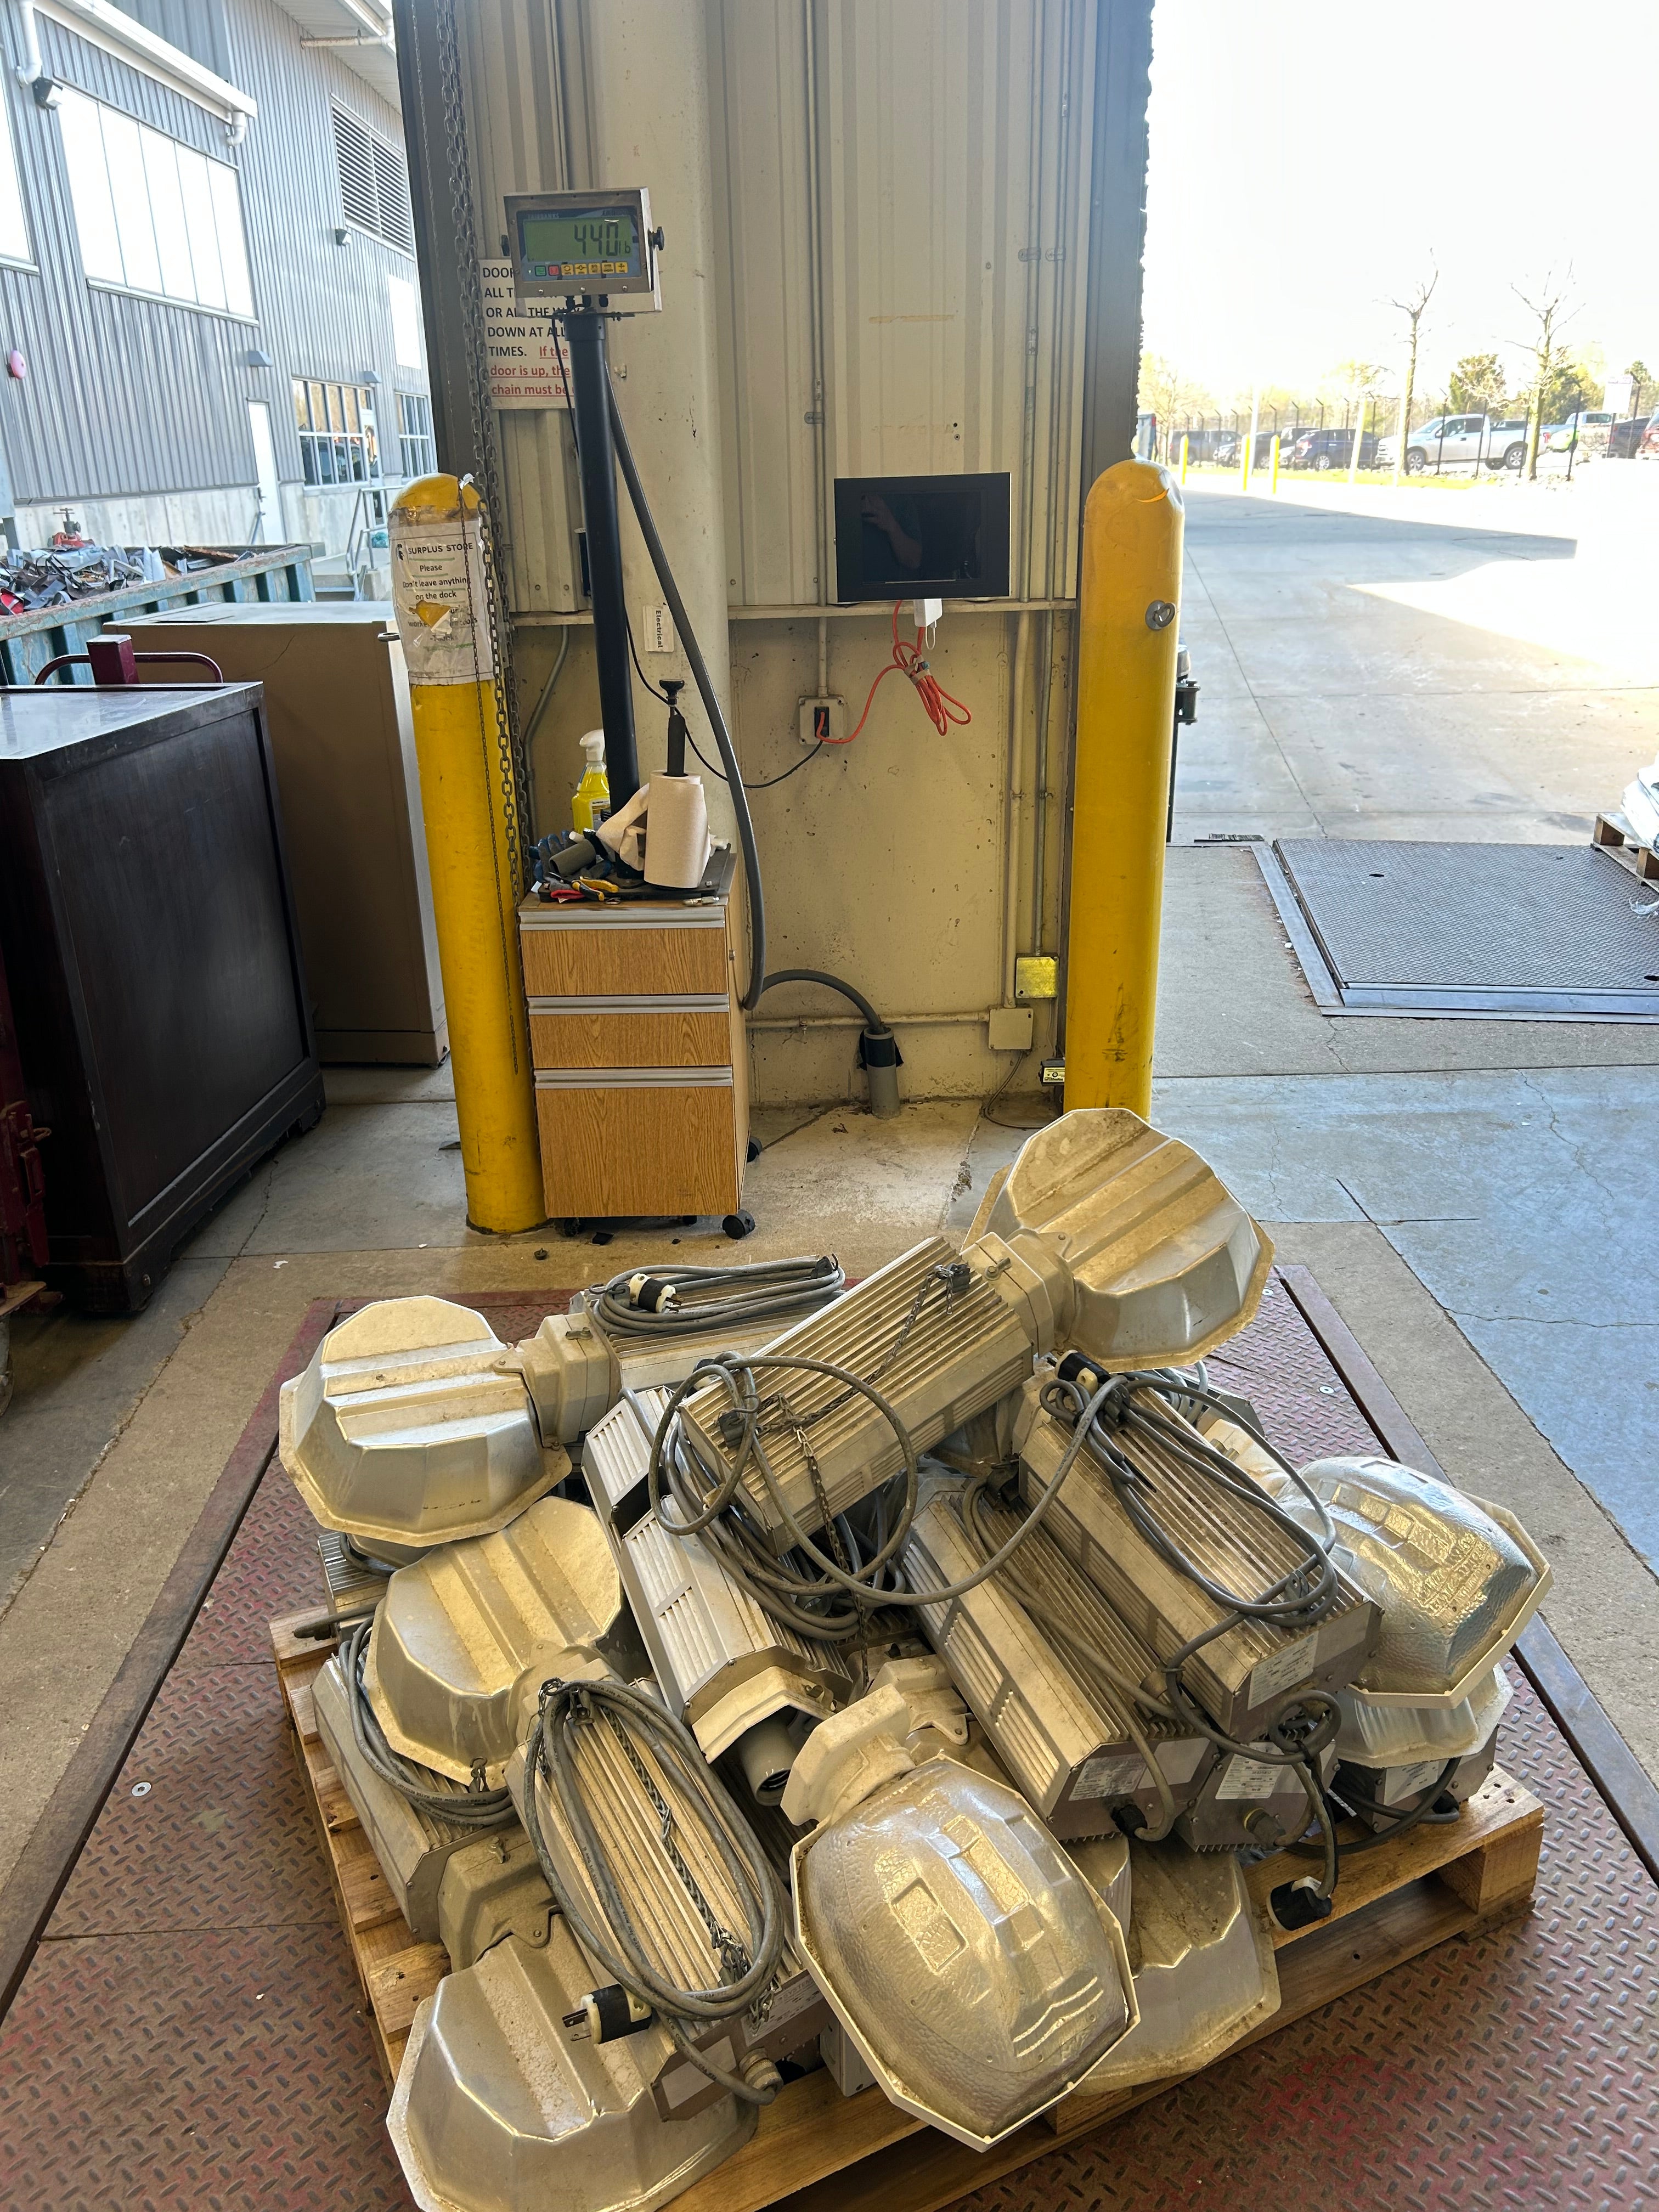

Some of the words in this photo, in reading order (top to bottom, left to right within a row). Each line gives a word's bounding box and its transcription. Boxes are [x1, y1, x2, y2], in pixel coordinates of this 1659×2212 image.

[574, 223, 619, 256] 440
[484, 287, 505, 298] ALL
[486, 307, 503, 318] OR
[488, 327, 525, 337] DOWN
[529, 327, 543, 337] AT
[488, 346, 527, 357] TIMES.
[540, 346, 548, 357] If
[490, 365, 517, 376] door
[520, 365, 528, 376] is
[532, 368, 549, 377] up,
[492, 385, 521, 394] chain
[525, 386, 553, 394] must
[408, 545, 443, 555] SURPLUS
[419, 579, 437, 588] leave
[439, 577, 471, 586] anythin
[439, 590, 457, 599] dock
